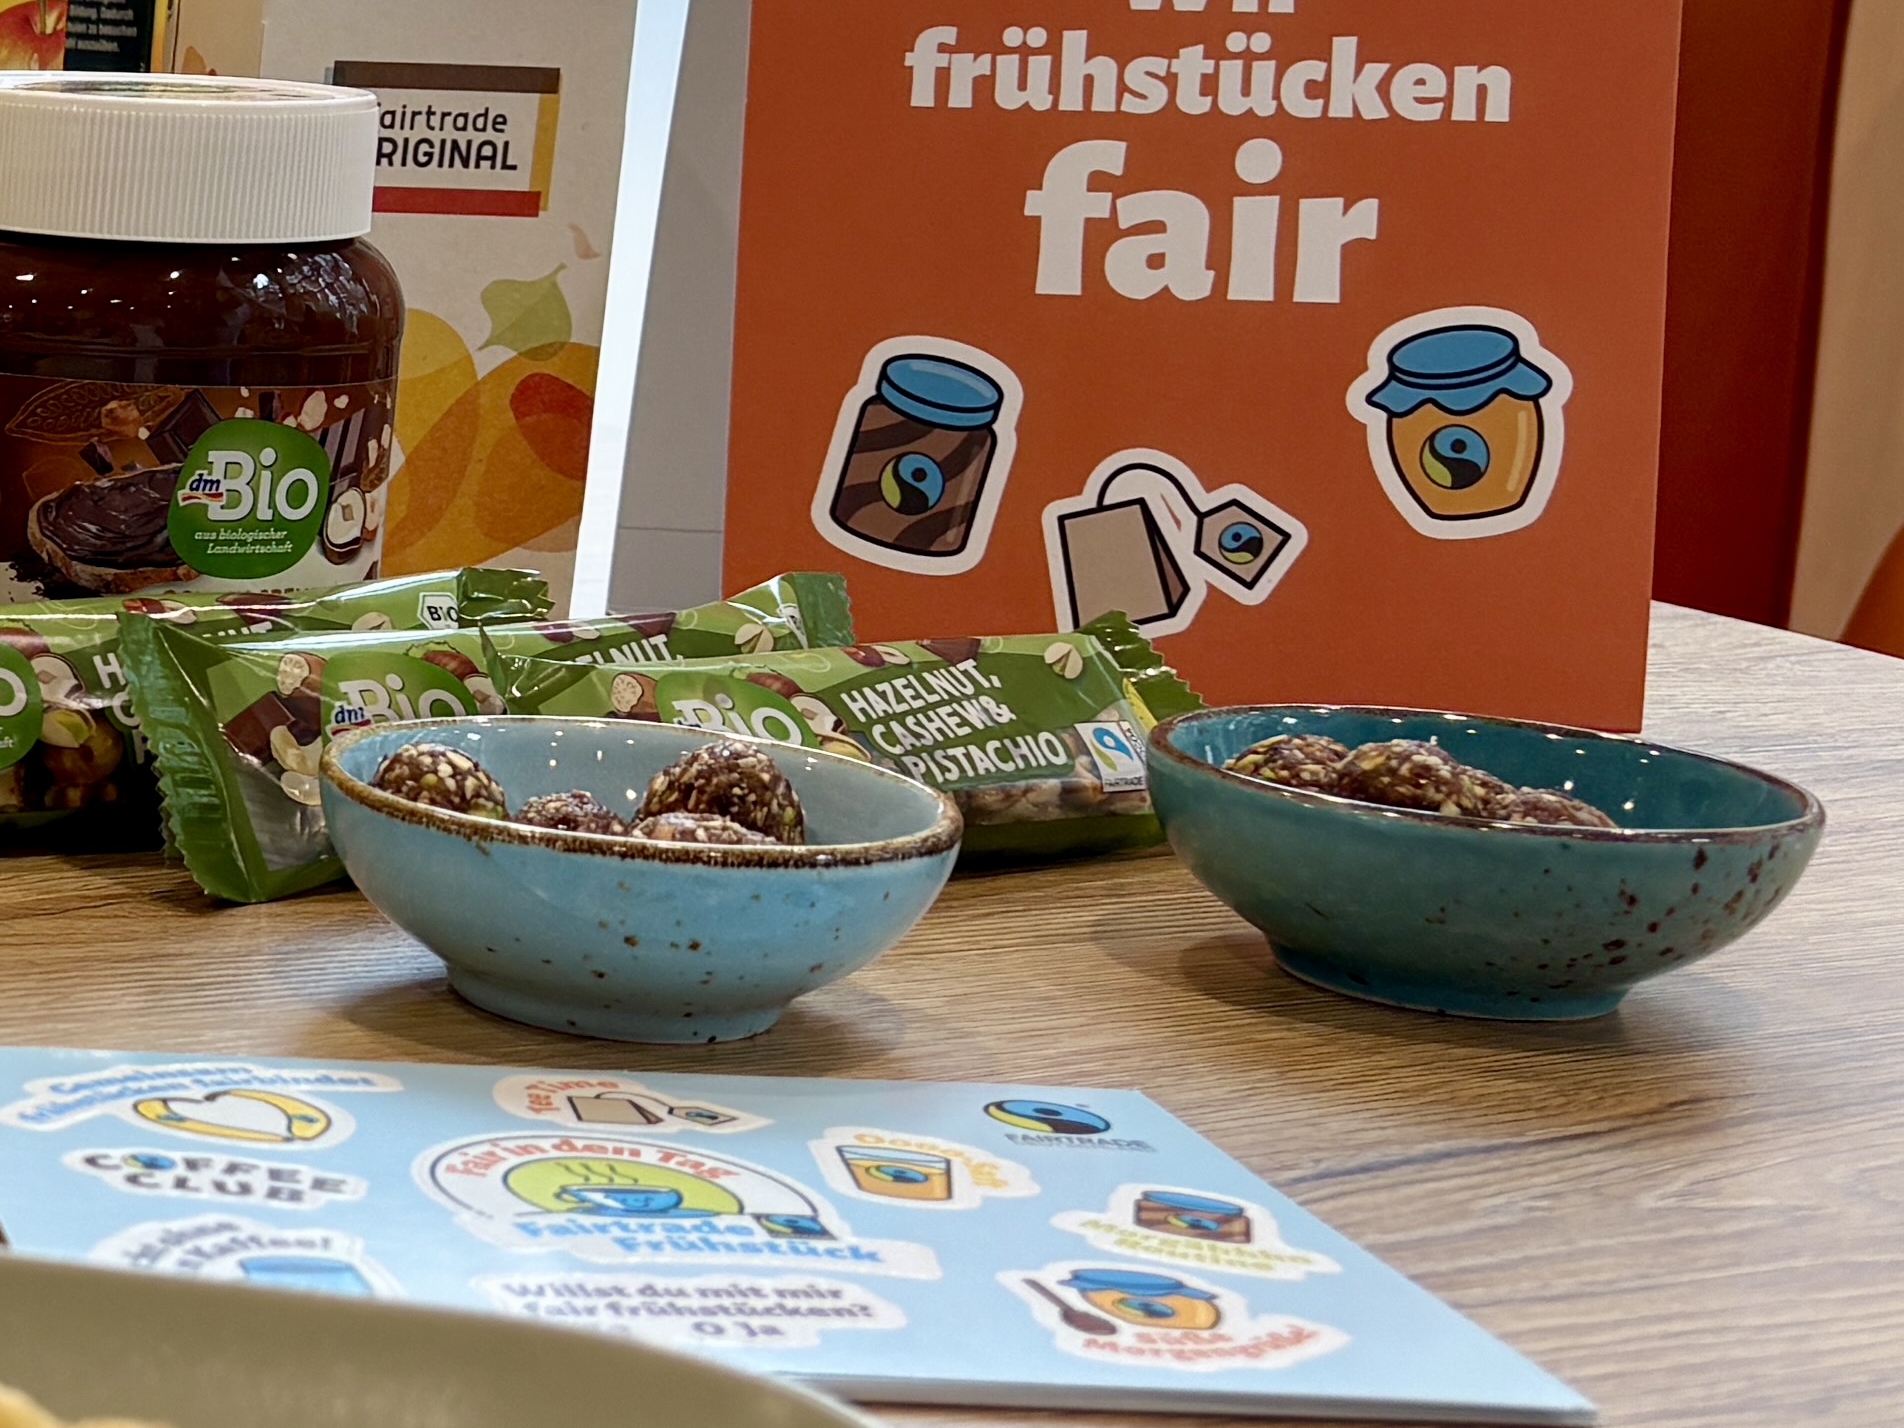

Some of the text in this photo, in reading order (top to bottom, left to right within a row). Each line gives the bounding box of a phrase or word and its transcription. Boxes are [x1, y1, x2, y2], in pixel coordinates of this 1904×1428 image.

[904, 26, 1512, 123] frühstücken
[377, 136, 518, 171] RIGINAL
[1023, 138, 1379, 303] fair
[187, 447, 319, 522] dm Bio
[194, 528, 288, 543] aus biologischer
[332, 671, 465, 726] dm Bio
[841, 658, 1001, 723] HAZELNUT,
[672, 692, 804, 746] Bio
[909, 730, 1068, 784] PISTACHIO
[444, 1137, 743, 1181] Fair in den Tag
[1004, 1133, 1150, 1149] FAIRTRADE
[123, 1171, 306, 1204] CLUB
[512, 1217, 755, 1239] Fairtrade
[611, 1234, 883, 1263] Frühstück
[502, 1282, 627, 1300] Willst
[636, 1283, 687, 1299] du
[695, 1284, 768, 1300] mit
